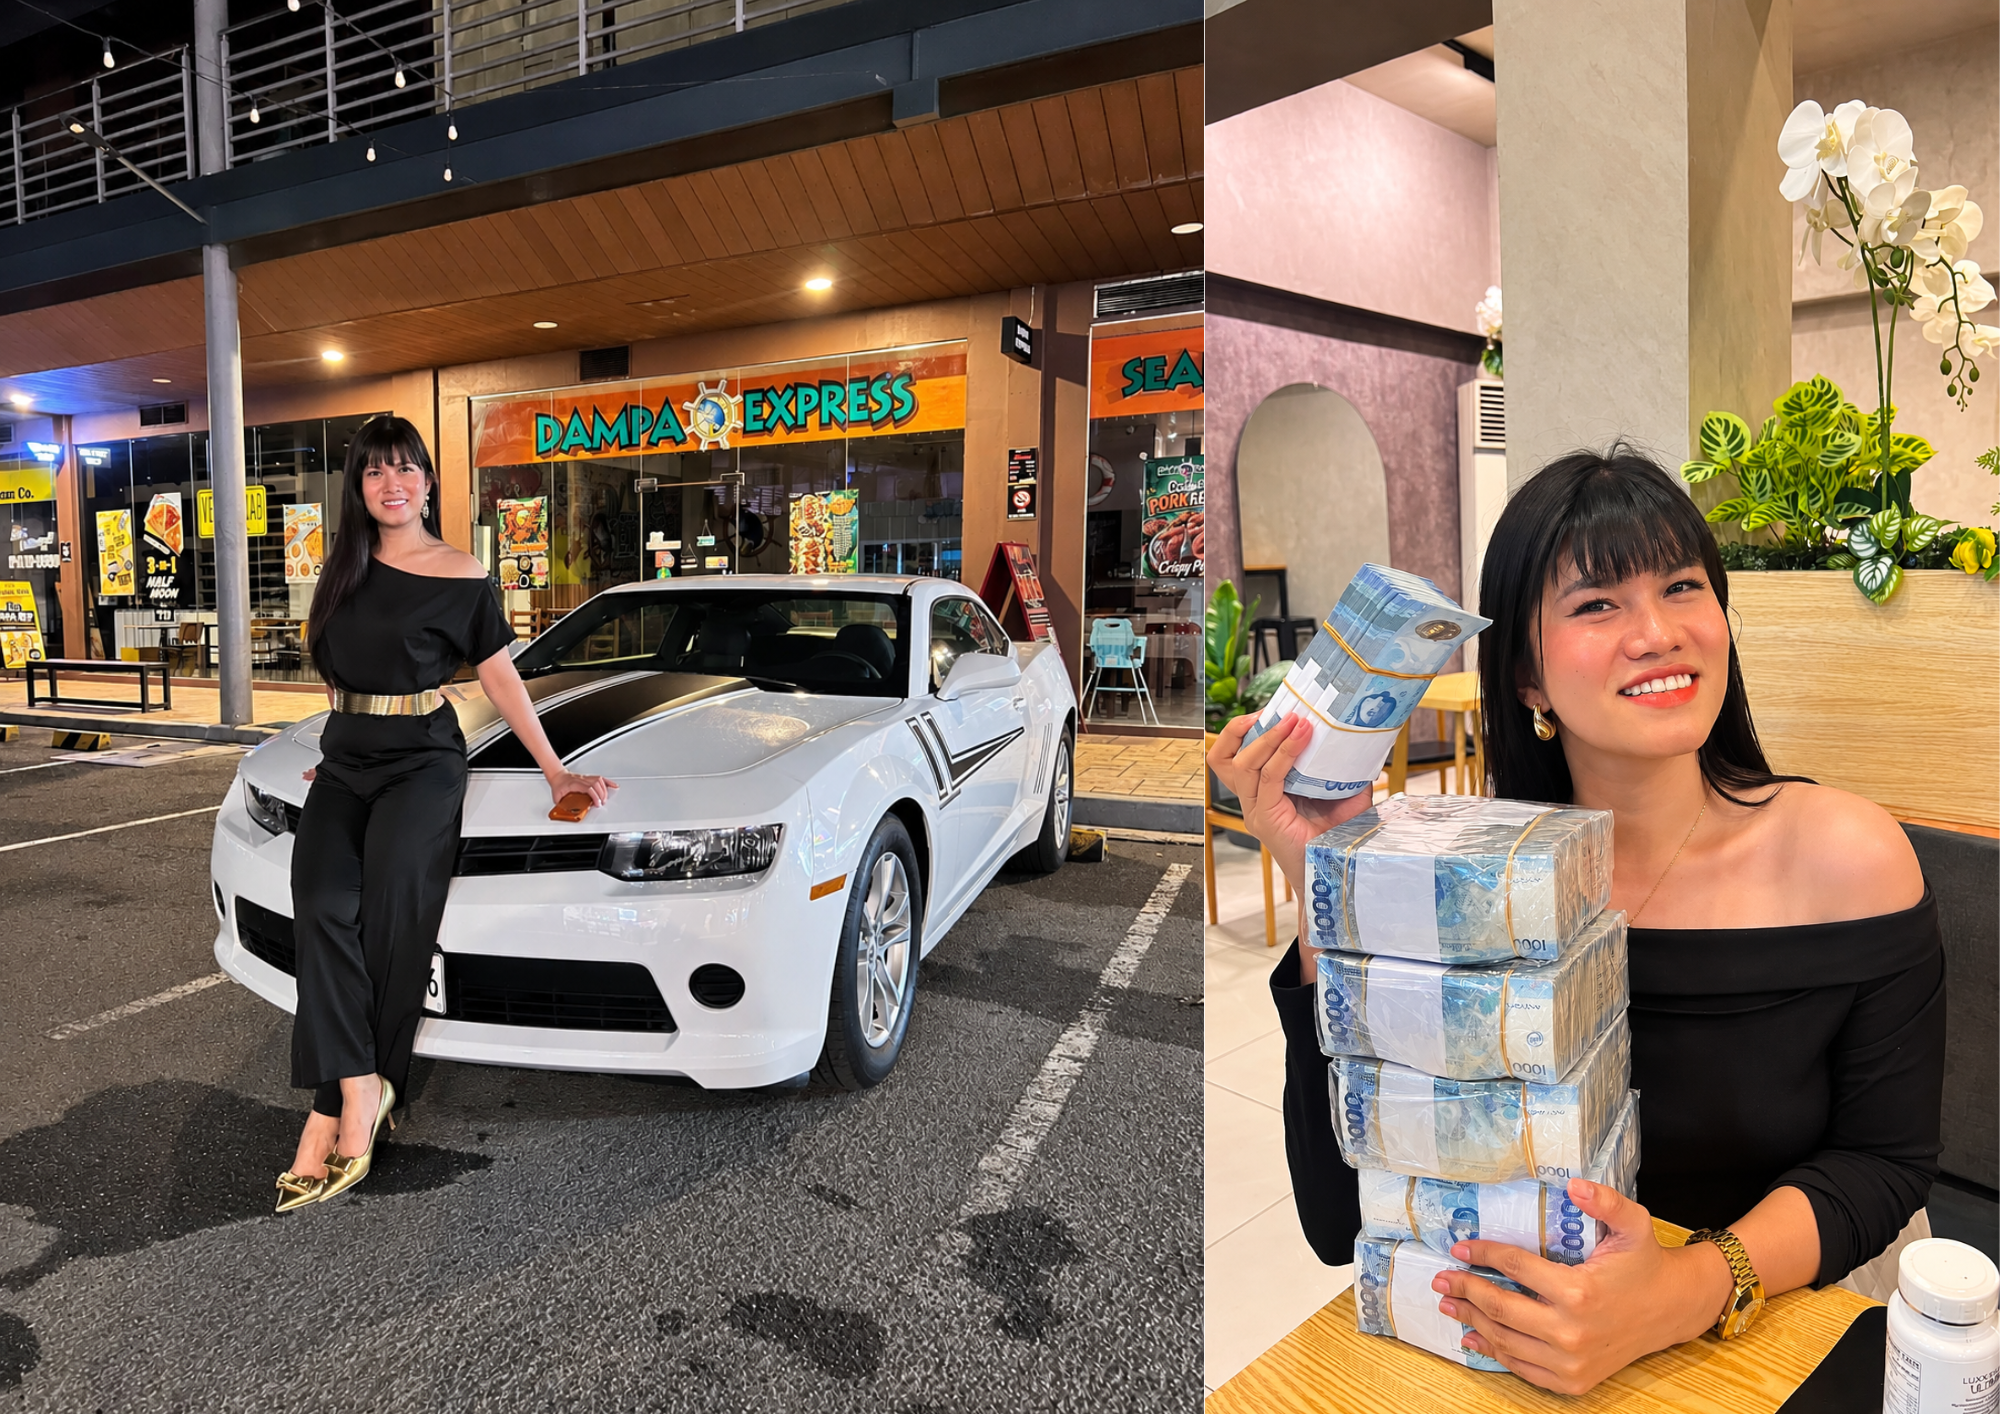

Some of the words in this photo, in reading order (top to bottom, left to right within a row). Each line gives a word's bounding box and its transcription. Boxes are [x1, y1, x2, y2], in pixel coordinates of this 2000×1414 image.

[1121, 347, 1204, 399] SEA
[535, 396, 687, 455] DAMPA
[743, 371, 918, 438] EXPRESS
[18, 486, 34, 500] Co.
[246, 492, 262, 520] AB
[1148, 492, 1189, 516] PORK
[1158, 560, 1192, 577] Crispy
[1312, 879, 1337, 945] 1000
[1560, 1189, 1585, 1251] 000
